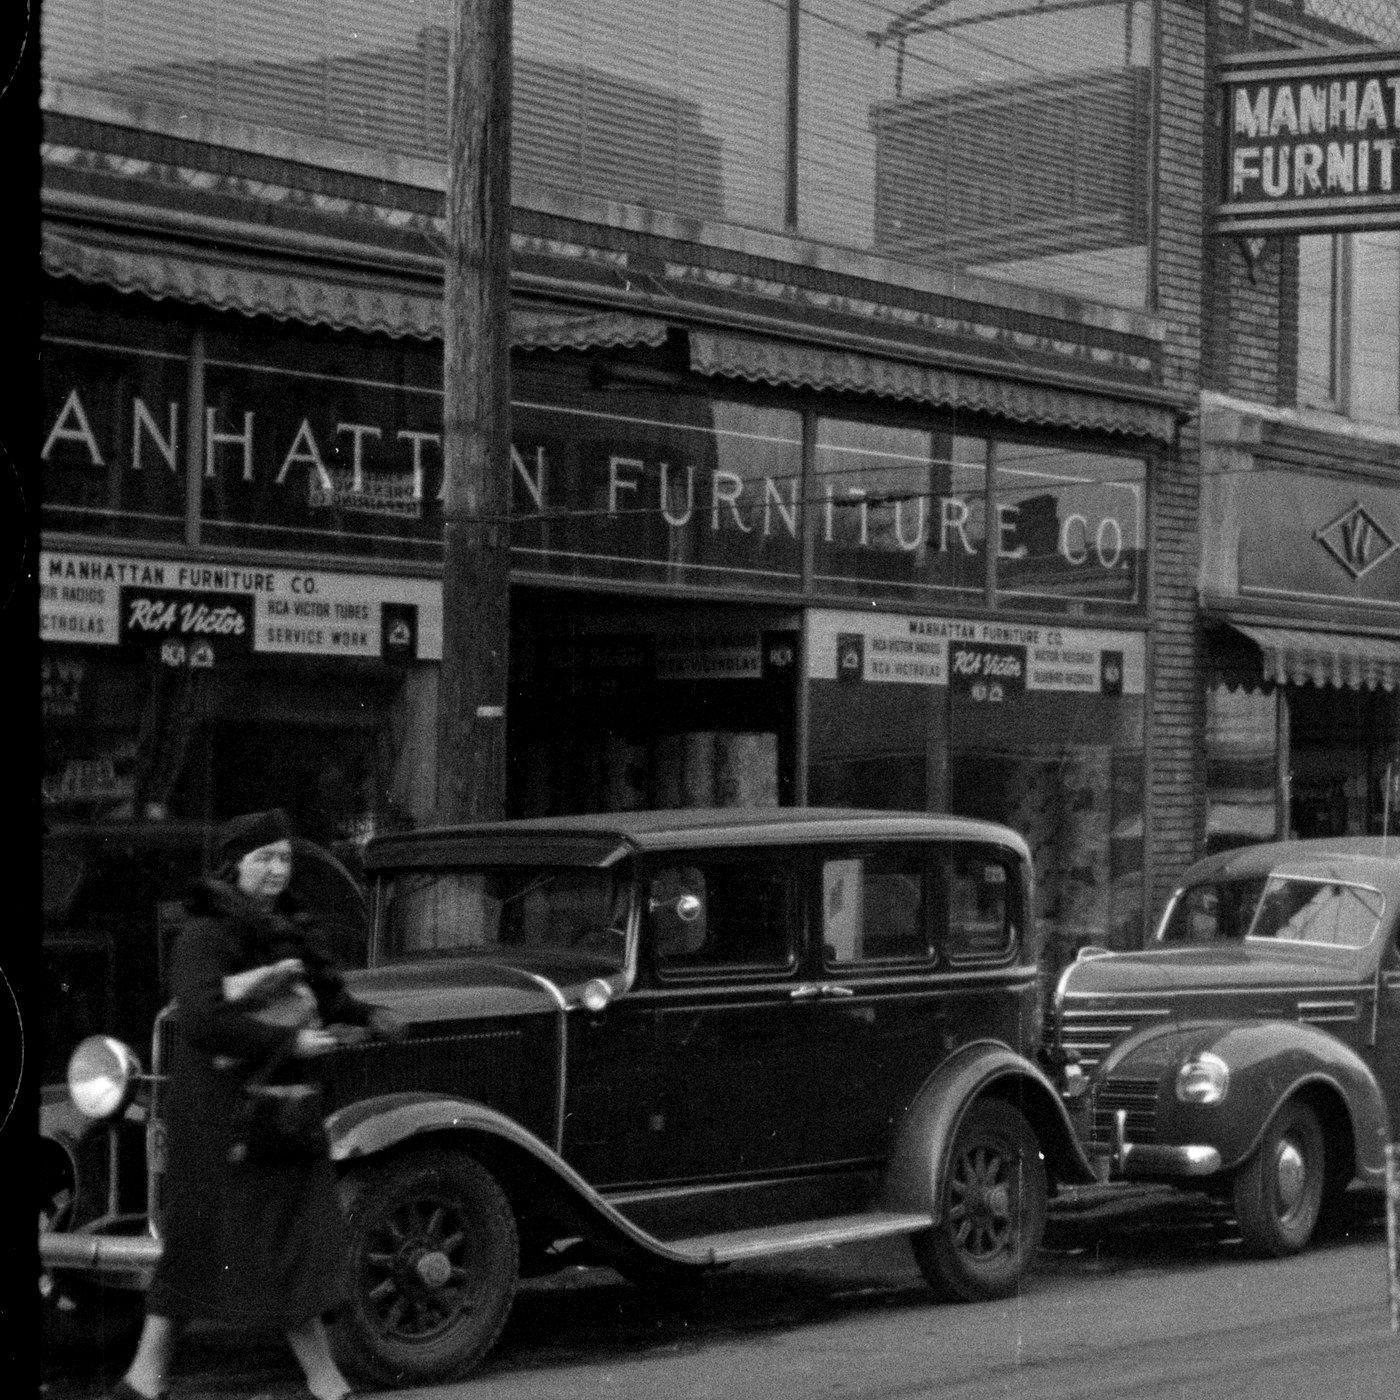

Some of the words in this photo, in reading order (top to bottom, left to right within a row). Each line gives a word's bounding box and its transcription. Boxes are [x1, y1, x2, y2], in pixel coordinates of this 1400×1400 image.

[41, 389, 547, 511] ANHATTN
[608, 457, 1027, 559] FURNITURE
[1061, 515, 1130, 569] CO.
[49, 560, 165, 585] MANHATTAN
[178, 566, 275, 593] FURNITURE
[62, 586, 105, 605] RADIOS
[128, 599, 178, 631] RCA
[180, 602, 246, 636] Victor
[334, 603, 369, 620] TUBES
[267, 627, 324, 645] SERVICE
[331, 632, 368, 647] WORK
[908, 621, 976, 638] MANHATTAN
[982, 625, 1040, 644] FURNITURE
[953, 651, 982, 675] RCA
[982, 653, 1021, 678] Victor
